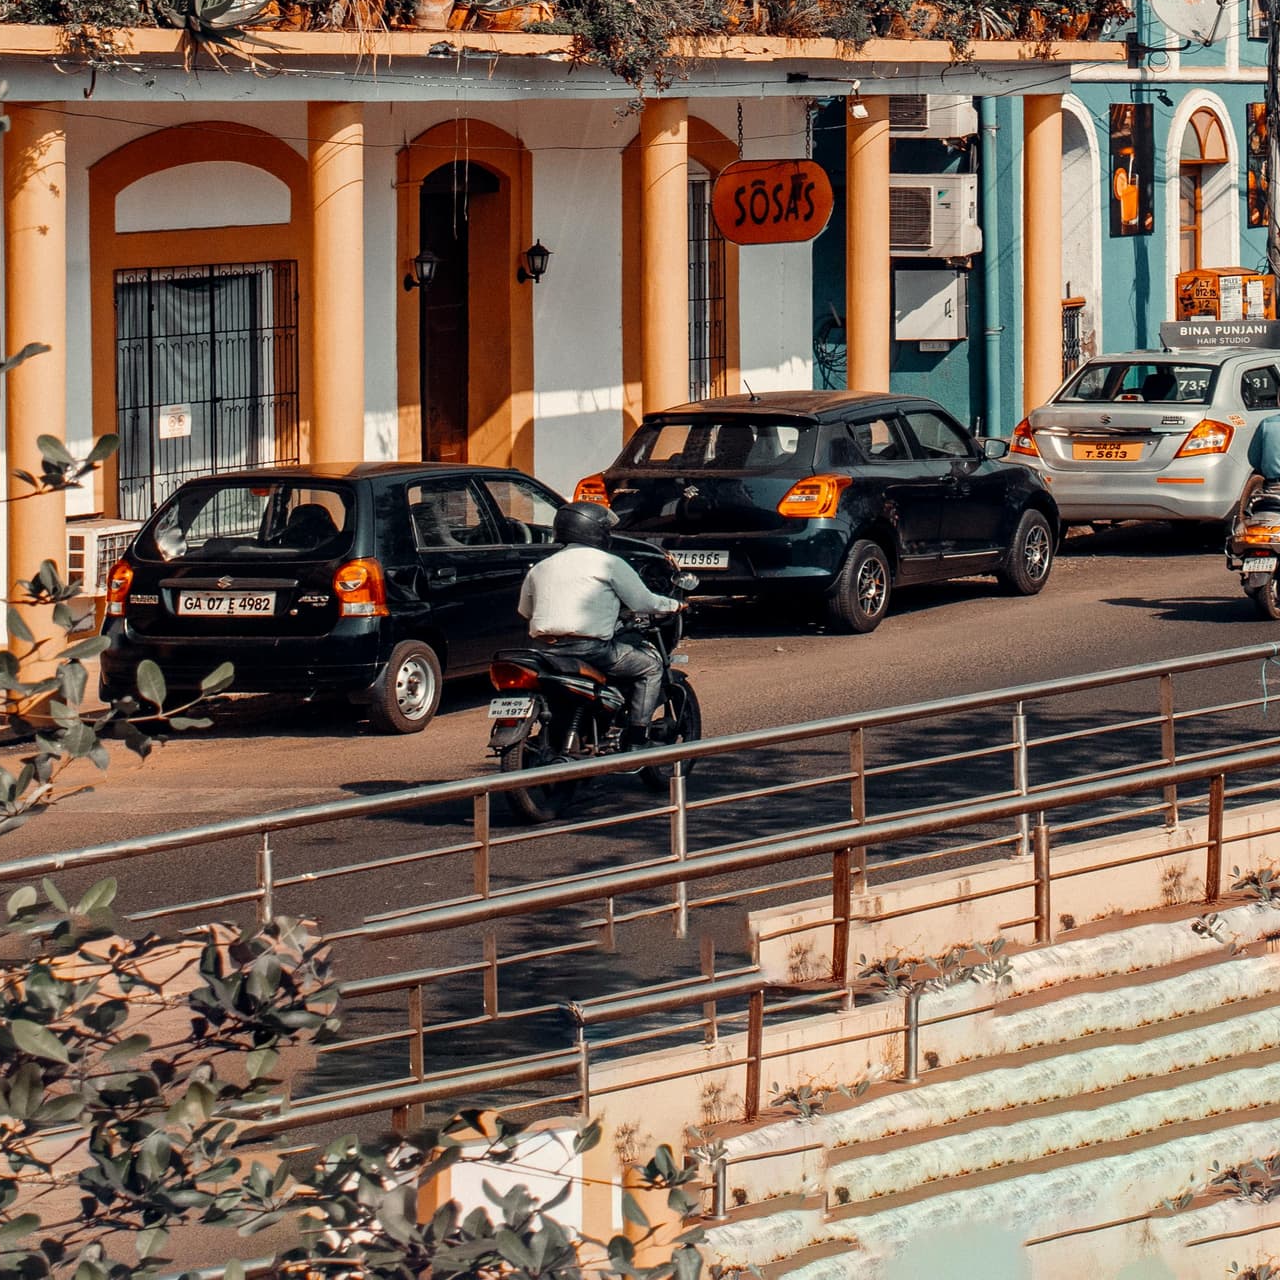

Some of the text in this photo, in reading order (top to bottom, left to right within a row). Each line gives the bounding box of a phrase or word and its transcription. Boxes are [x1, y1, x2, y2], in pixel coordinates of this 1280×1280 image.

[1180, 325, 1267, 336] BINA PUNJANI
[1197, 336, 1251, 345] HAIR STUDIO
[184, 597, 270, 611] GA 07 E 4982
